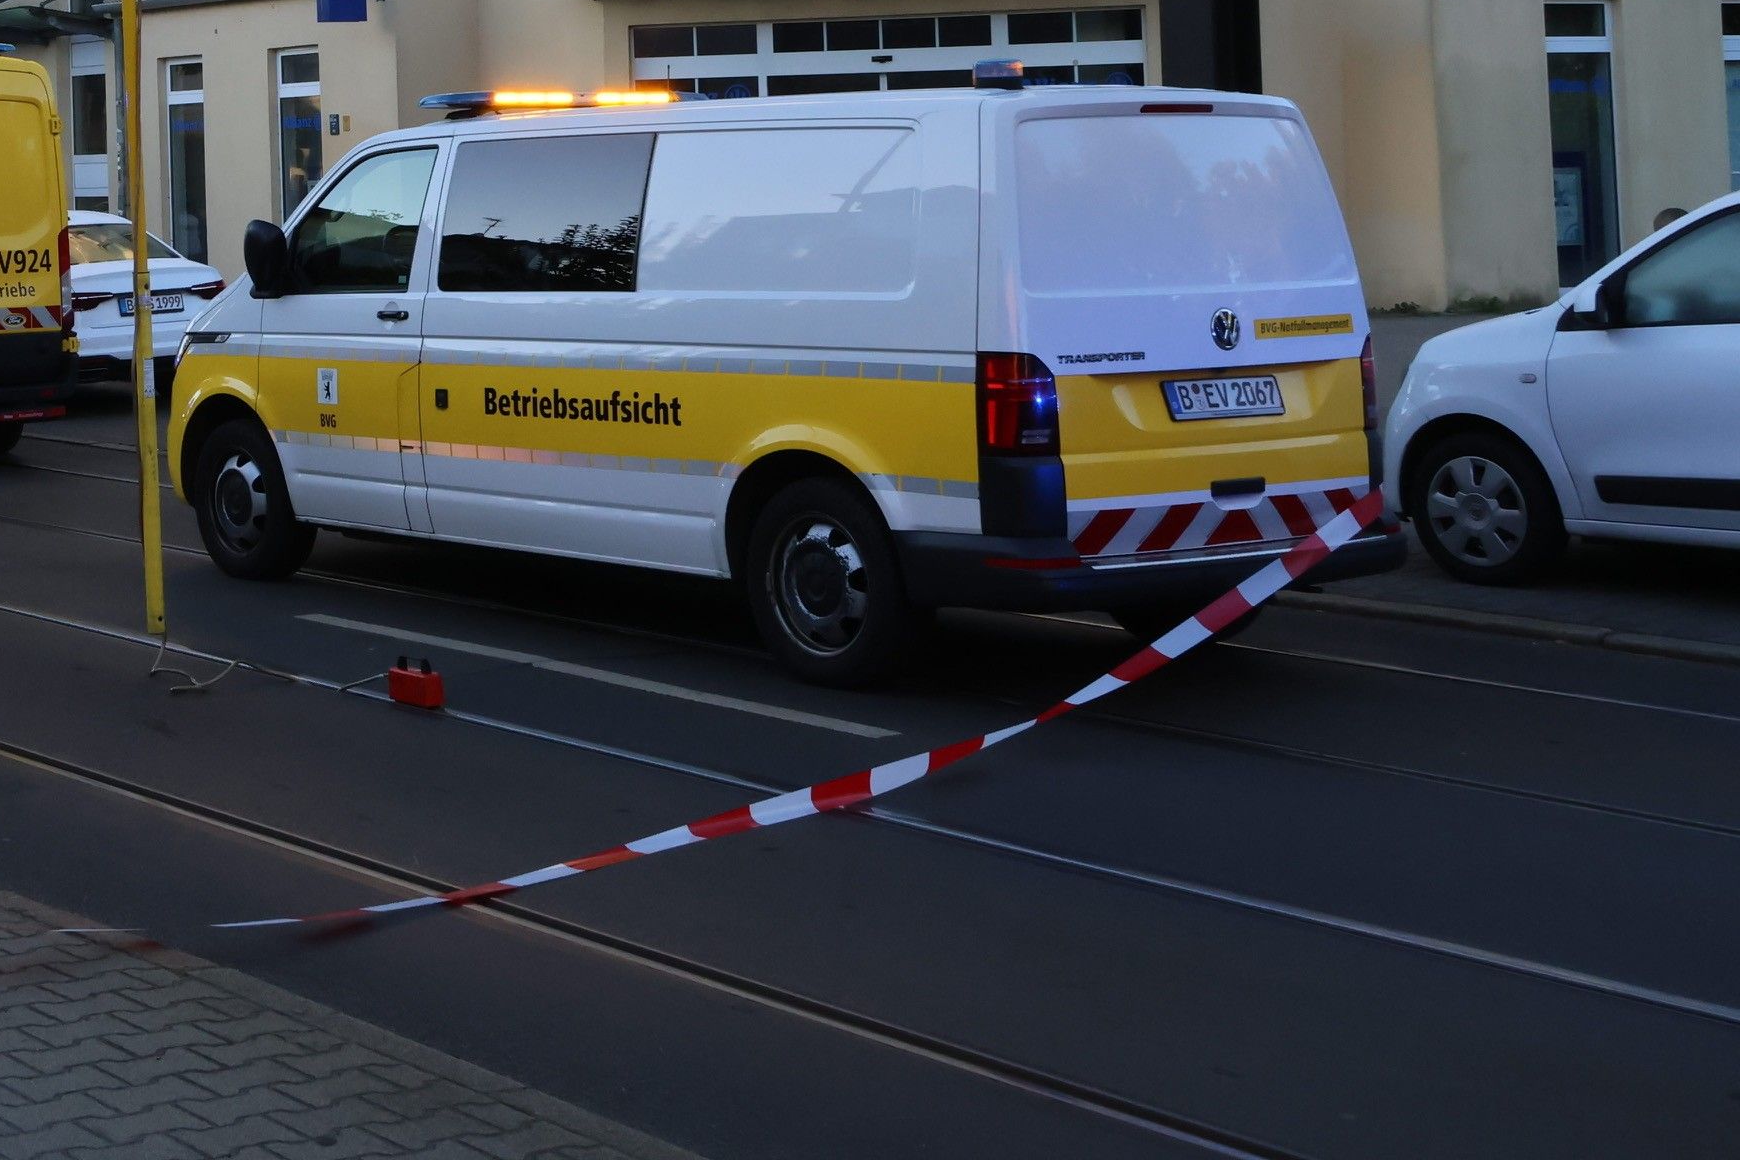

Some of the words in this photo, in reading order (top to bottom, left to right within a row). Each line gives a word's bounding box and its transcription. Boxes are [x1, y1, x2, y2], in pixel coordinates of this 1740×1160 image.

[155, 295, 181, 309] 1999
[1056, 351, 1145, 364] TRANSPORTER
[1177, 385, 1194, 410] B
[1201, 382, 1229, 408] EV
[1230, 380, 1275, 406] 2067
[483, 386, 682, 427] Betriebsaufsicht
[320, 413, 337, 428] BVG
